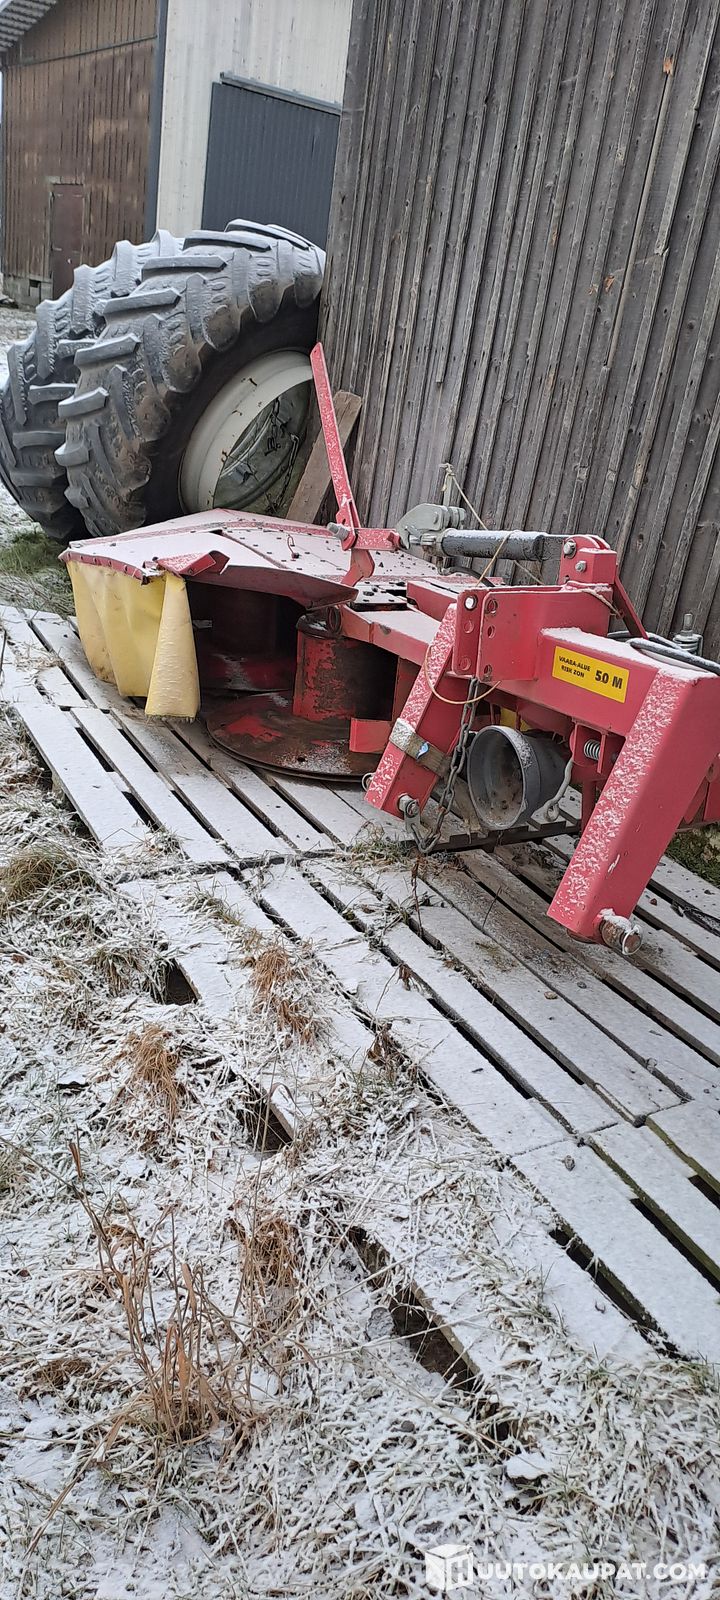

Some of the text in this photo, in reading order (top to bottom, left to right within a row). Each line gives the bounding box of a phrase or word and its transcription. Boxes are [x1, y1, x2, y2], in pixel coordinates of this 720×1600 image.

[561, 665, 572, 673] RISK
[595, 670, 623, 689] 50 M
